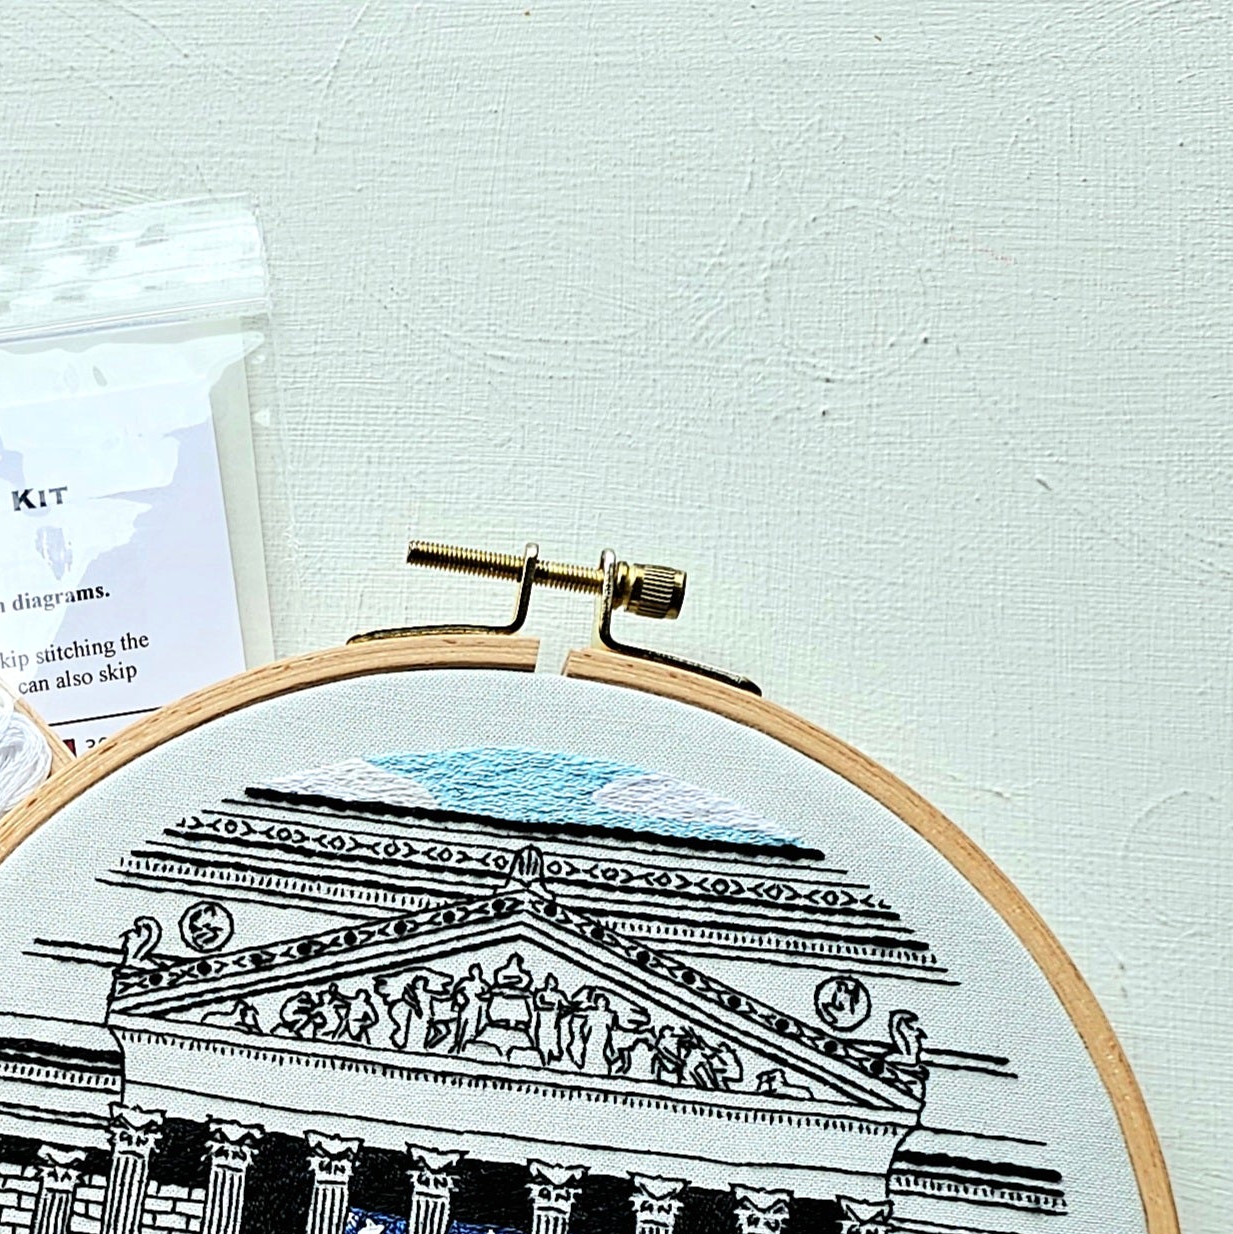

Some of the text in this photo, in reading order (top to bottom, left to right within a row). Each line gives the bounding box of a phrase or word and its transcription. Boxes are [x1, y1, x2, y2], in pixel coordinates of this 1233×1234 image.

[12, 486, 68, 512] KIT
[12, 584, 111, 613] diagrams.
[36, 638, 115, 668] stitching
[120, 630, 149, 653] the
[17, 674, 53, 696] can
[56, 668, 94, 689] also
[99, 660, 137, 686] skip
